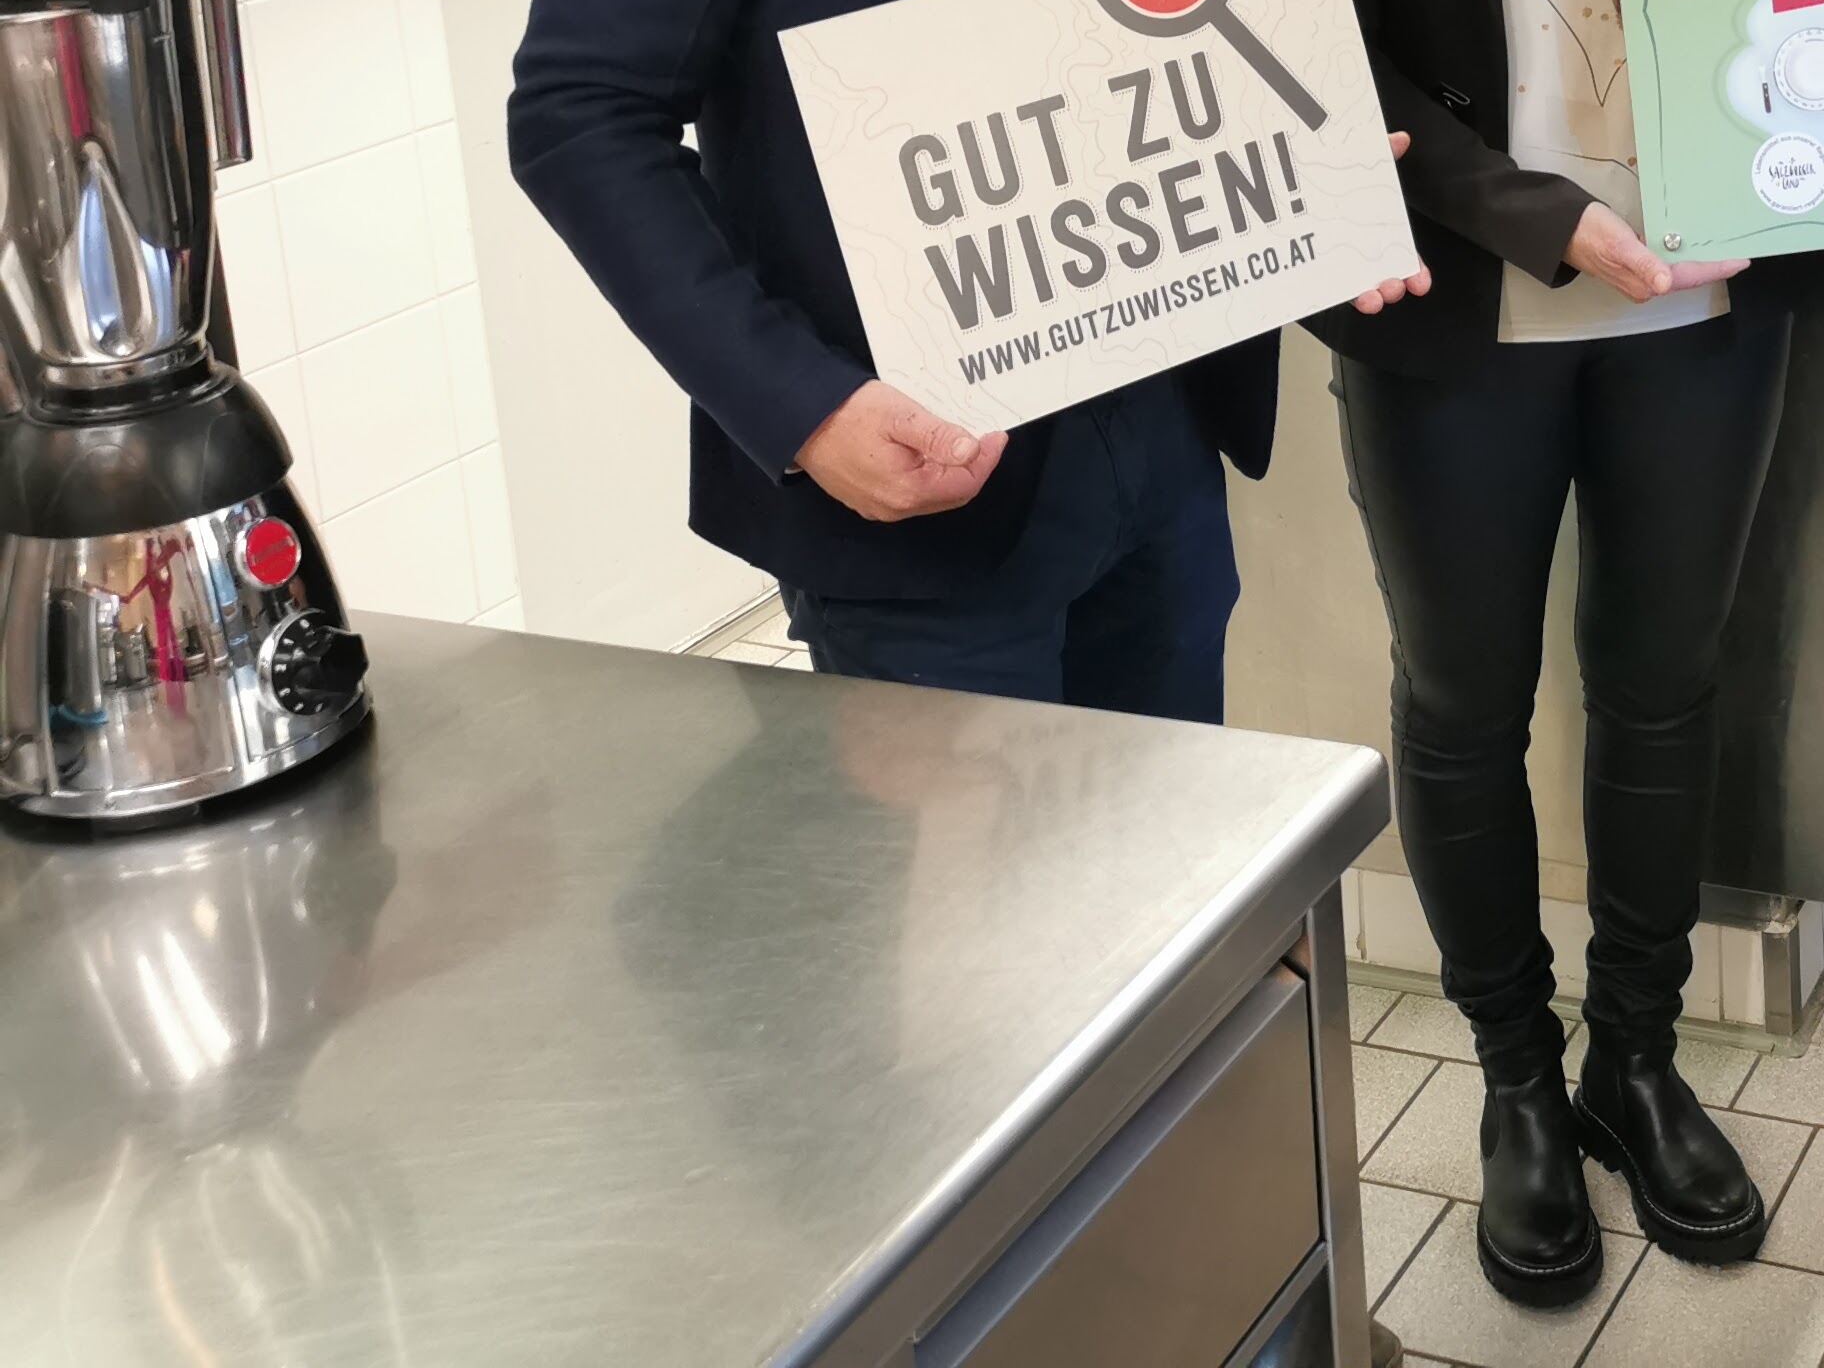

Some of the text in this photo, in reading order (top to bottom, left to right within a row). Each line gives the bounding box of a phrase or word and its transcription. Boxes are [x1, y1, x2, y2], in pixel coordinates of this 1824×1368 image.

[898, 50, 1224, 227] GUT ZU
[1781, 177, 1800, 191] LAND
[923, 130, 1307, 333] WISSEN!
[957, 232, 1319, 386] WWW.GUTZUWISSEN.CO.AT
